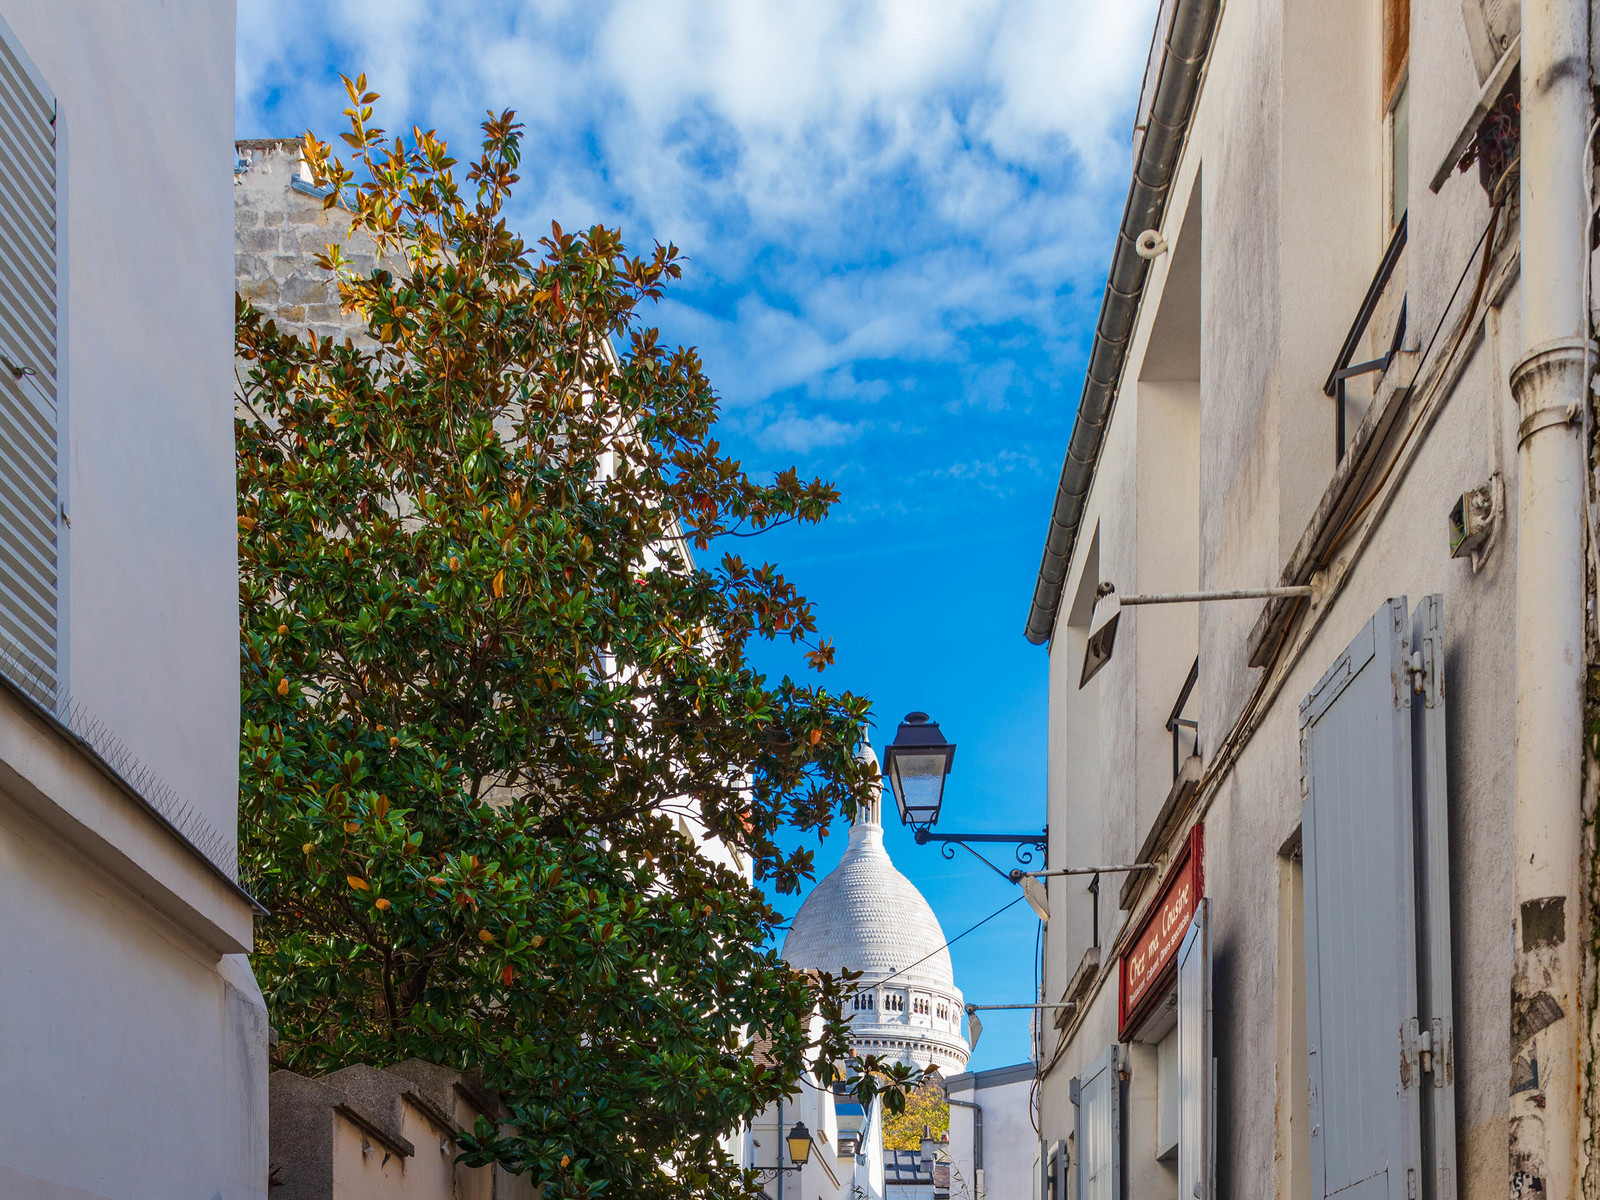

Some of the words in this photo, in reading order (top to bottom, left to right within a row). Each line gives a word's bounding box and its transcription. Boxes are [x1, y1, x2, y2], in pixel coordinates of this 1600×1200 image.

[1130, 953, 1146, 987] Chez
[1148, 933, 1160, 959] ma
[1162, 883, 1189, 937] Cousine
